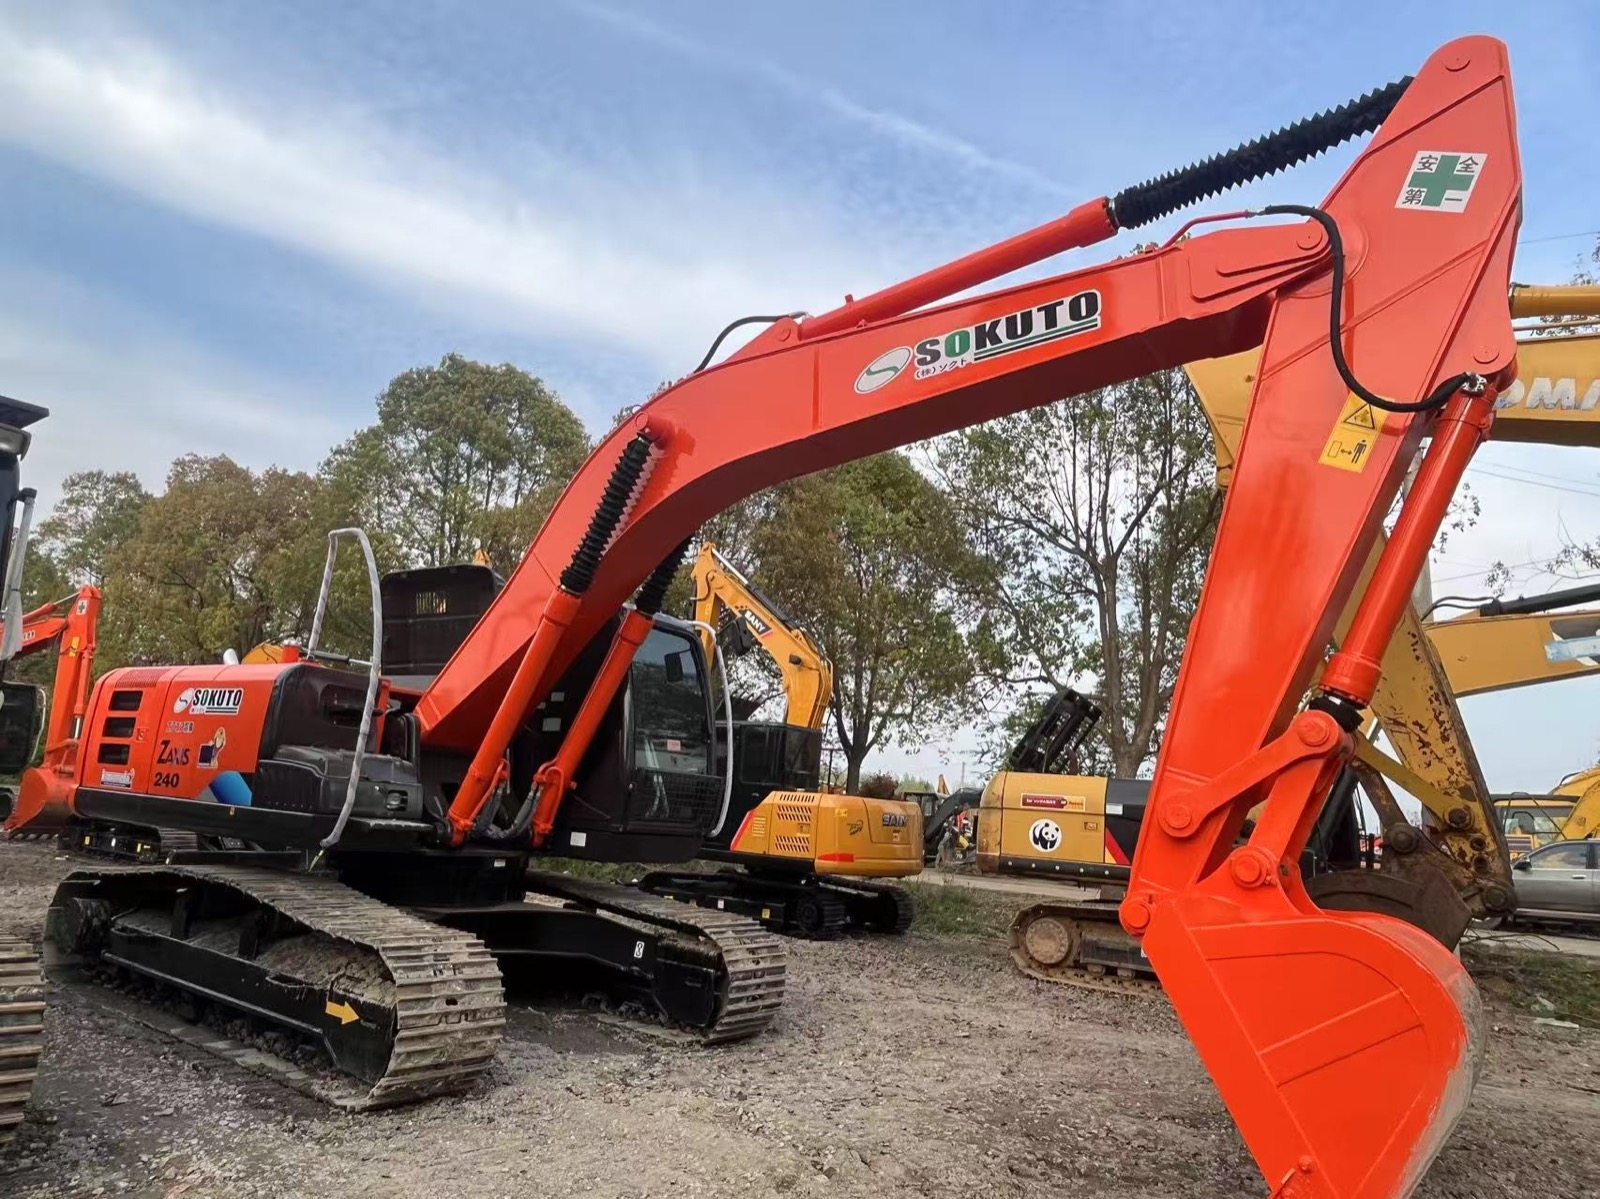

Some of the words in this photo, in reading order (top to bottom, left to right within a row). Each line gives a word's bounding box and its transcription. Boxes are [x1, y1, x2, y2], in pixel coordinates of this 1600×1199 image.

[915, 290, 1099, 368] SOKUTO
[744, 610, 766, 632] SANY
[192, 688, 243, 707] SOKUTO
[153, 771, 180, 788] 240
